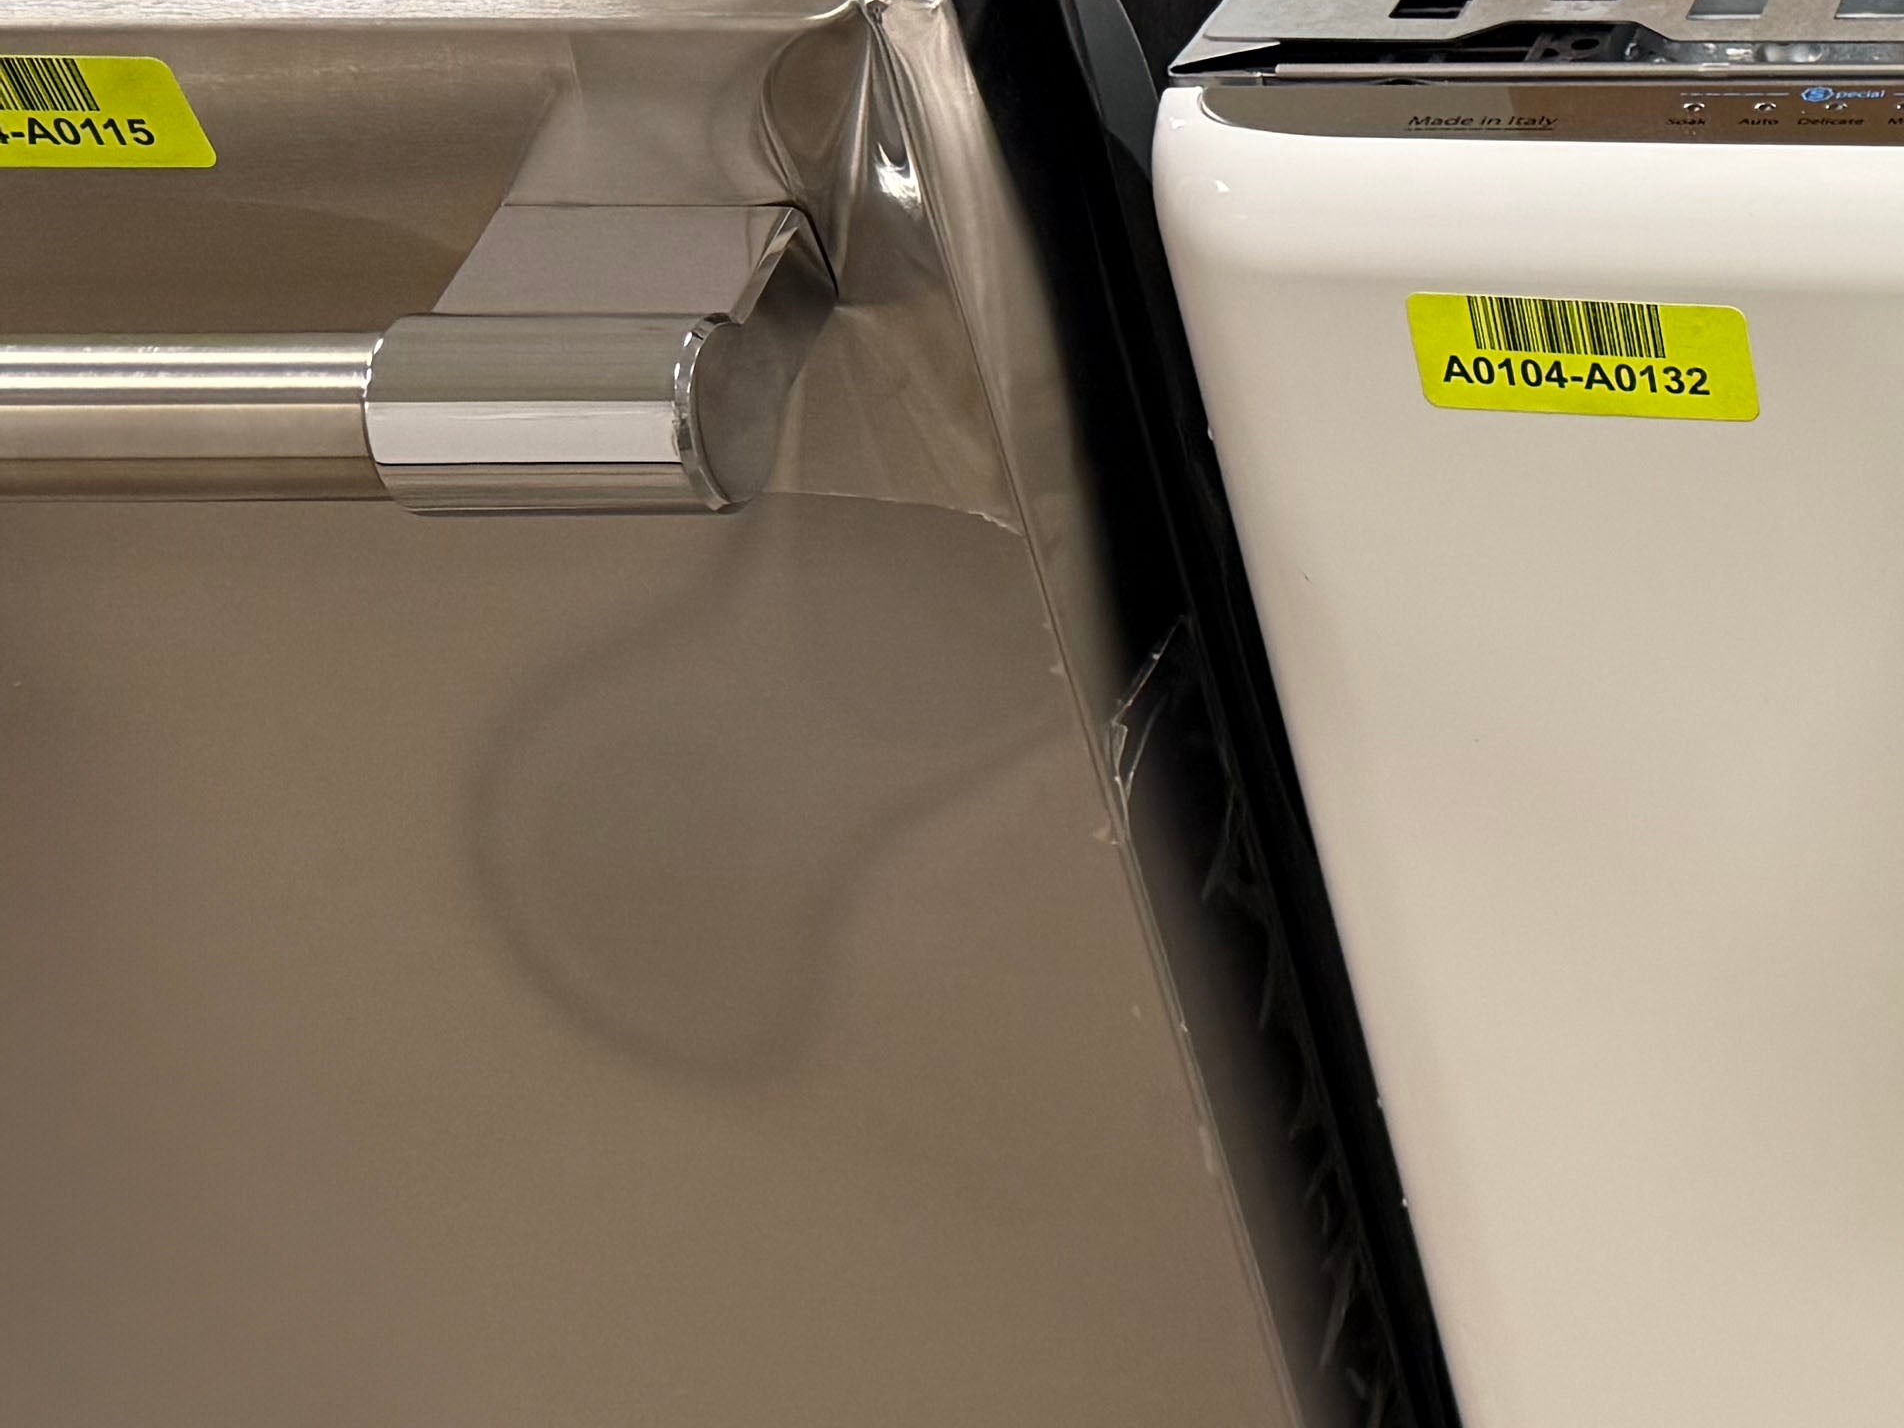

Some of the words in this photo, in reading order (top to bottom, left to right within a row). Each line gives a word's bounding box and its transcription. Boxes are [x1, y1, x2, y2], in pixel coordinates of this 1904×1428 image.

[1408, 115, 1474, 126] Made
[1480, 115, 1502, 126] in
[1508, 115, 1559, 128] Italy
[1667, 117, 1706, 126] Soak
[1738, 118, 1780, 126] Auto
[1797, 117, 1865, 126] Delicate
[1443, 355, 1711, 395] A0104-A0132
